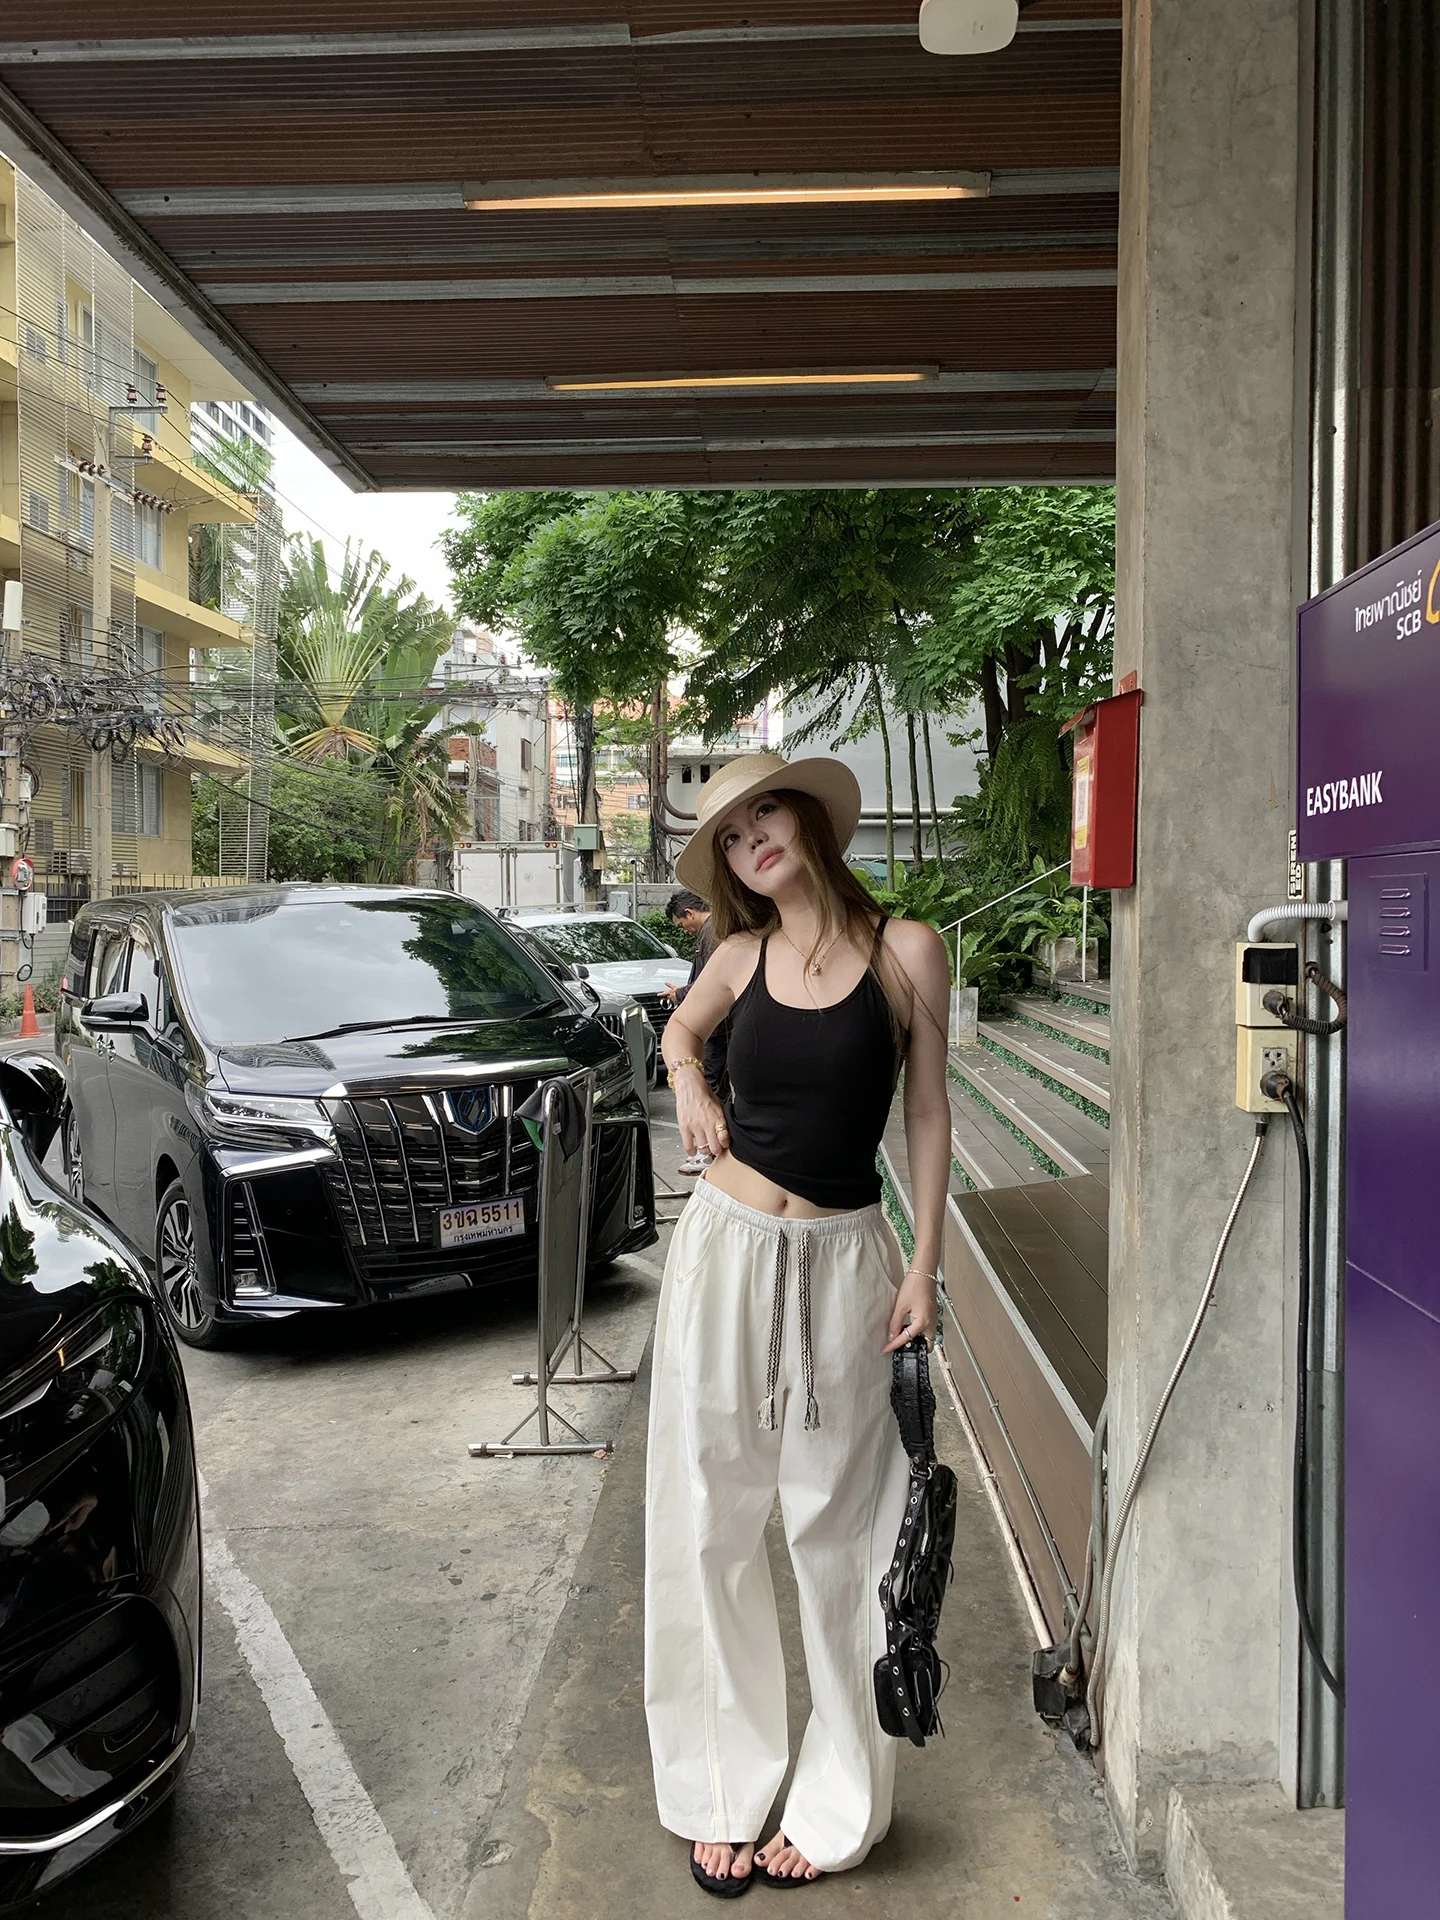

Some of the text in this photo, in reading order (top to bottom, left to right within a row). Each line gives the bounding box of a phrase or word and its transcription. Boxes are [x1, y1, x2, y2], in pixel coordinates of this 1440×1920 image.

[1355, 569, 1422, 633] ไทยพาณิชย์
[1396, 609, 1422, 641] SCB
[1306, 770, 1383, 817] EASYBANK
[481, 1201, 520, 1224] 5511
[453, 1225, 513, 1243] กรุงเทพมหานคร
